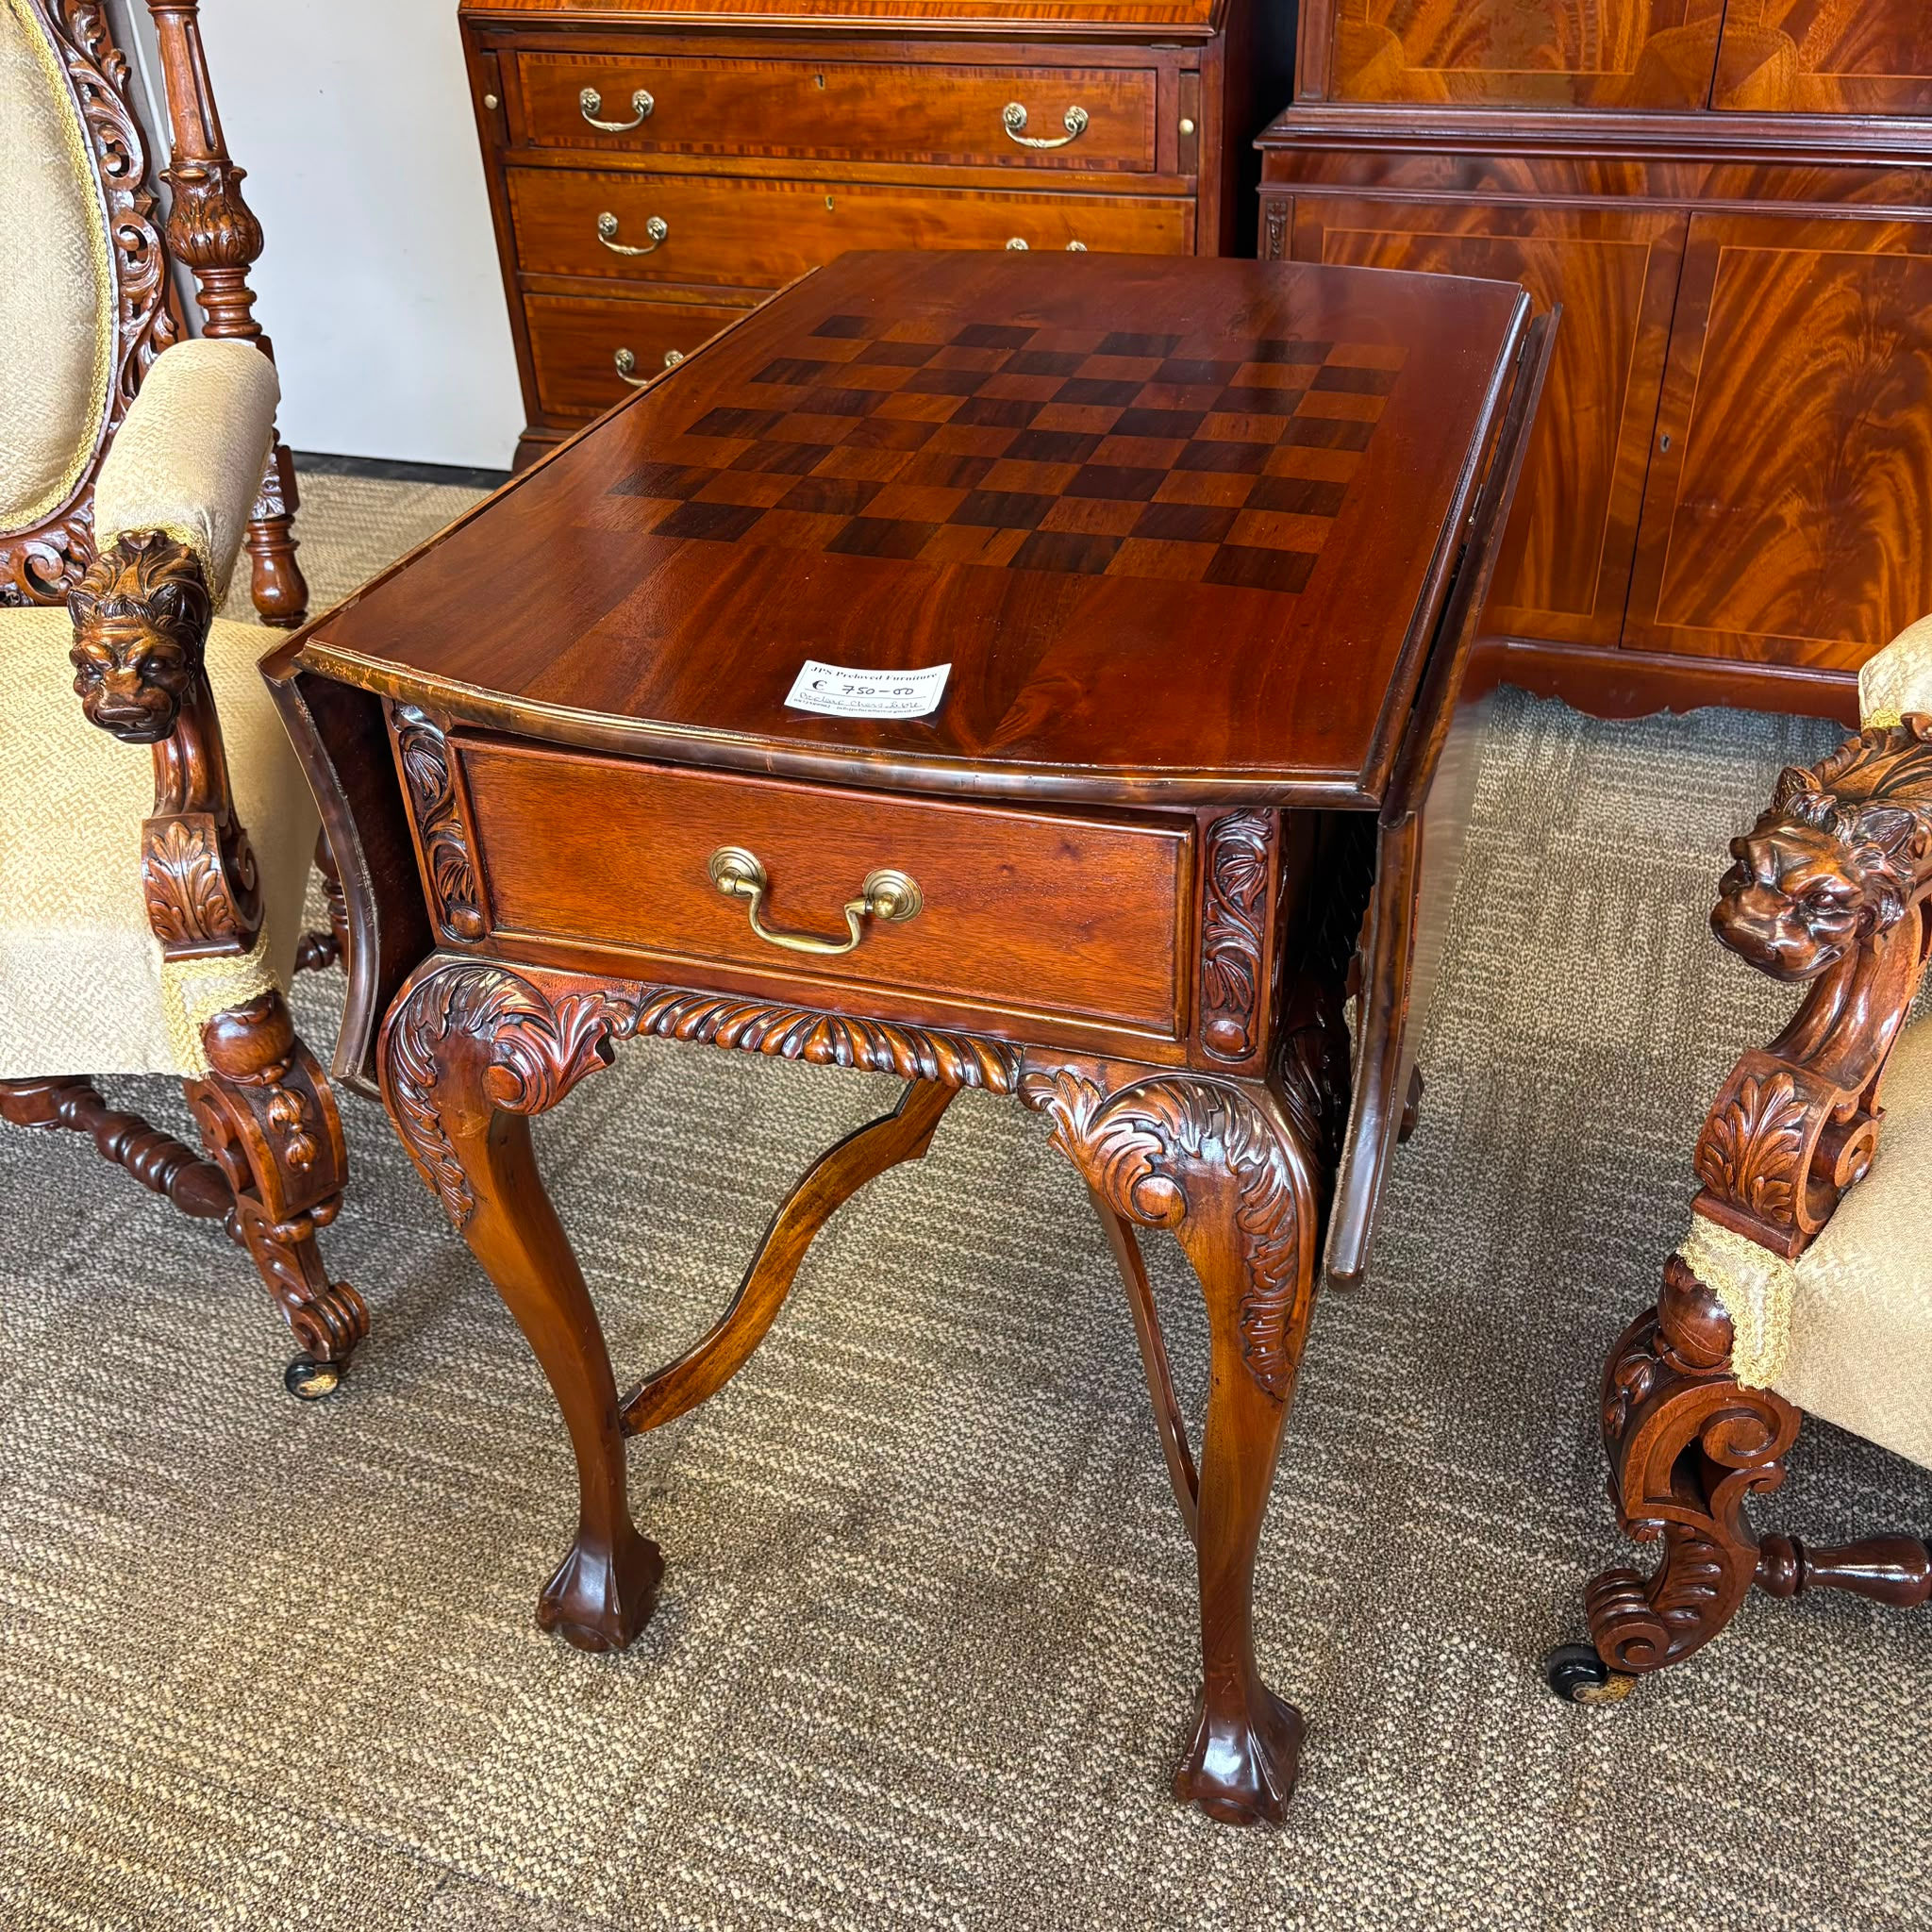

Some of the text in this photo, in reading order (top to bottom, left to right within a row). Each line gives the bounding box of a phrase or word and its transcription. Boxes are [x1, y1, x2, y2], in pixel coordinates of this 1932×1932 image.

[810, 666, 938, 681] JPS Preloved Furniture
[812, 679, 827, 691] €
